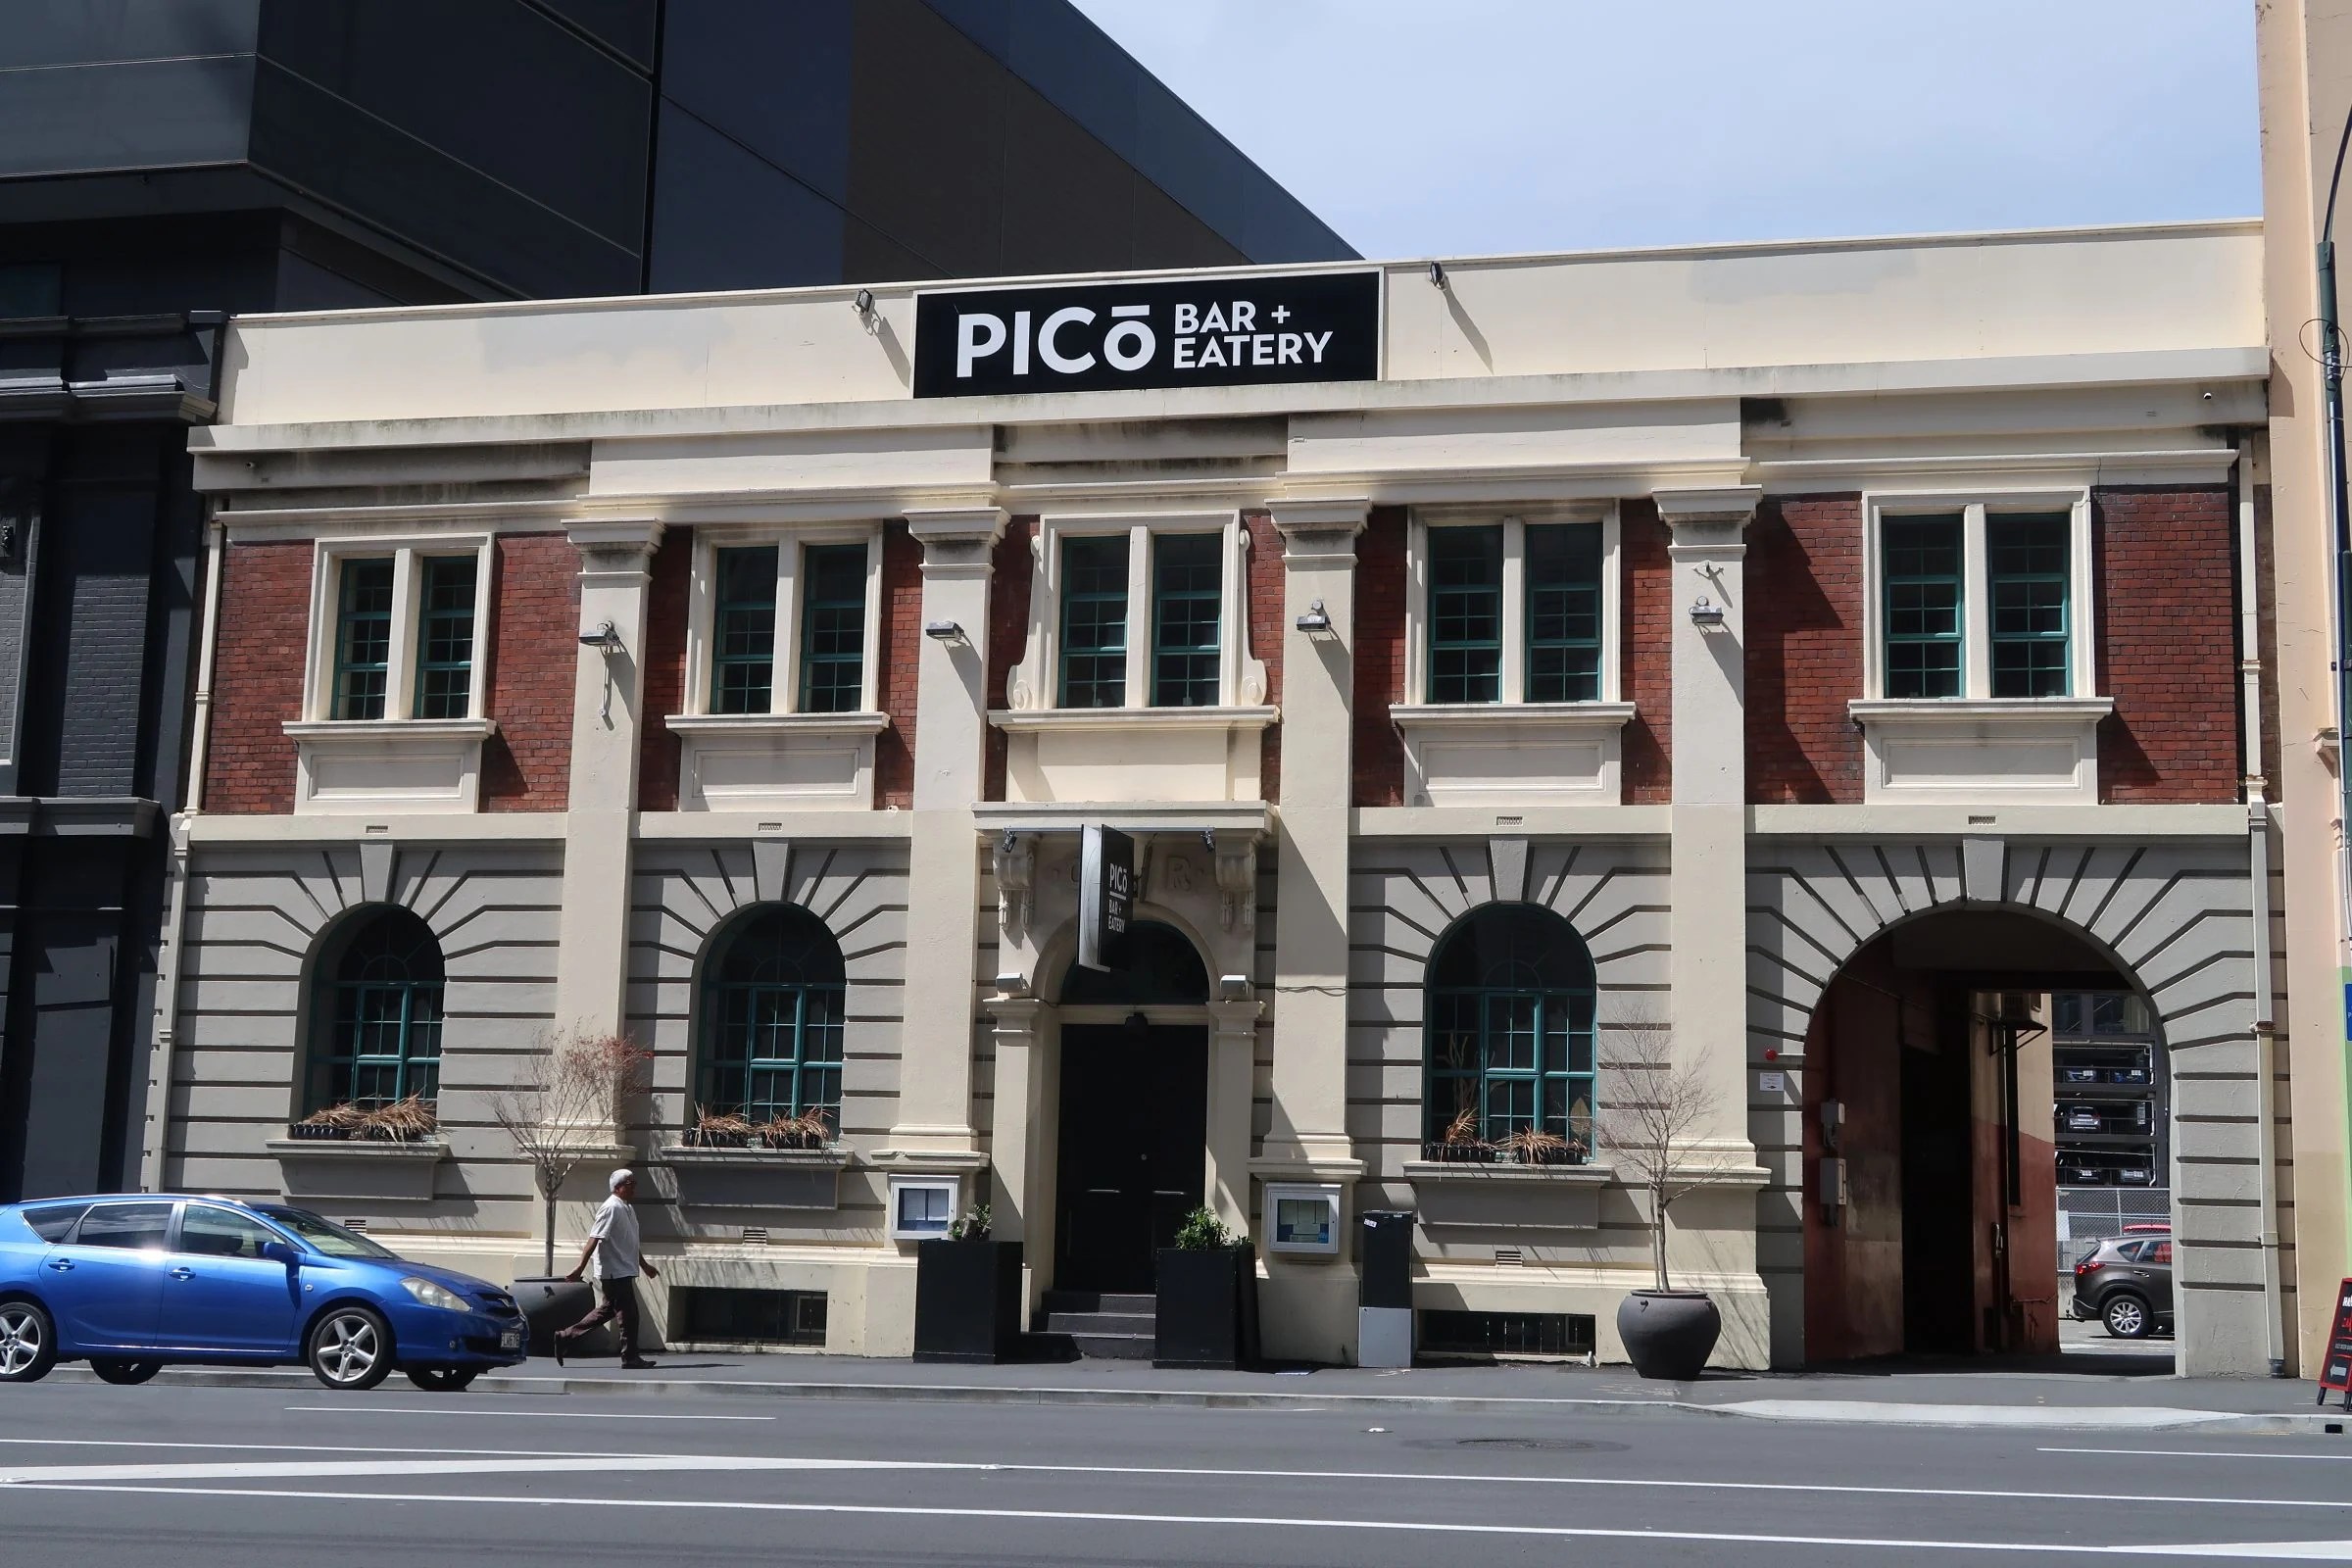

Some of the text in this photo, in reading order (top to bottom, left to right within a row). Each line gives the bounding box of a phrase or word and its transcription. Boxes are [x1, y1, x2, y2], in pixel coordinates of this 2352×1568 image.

[1174, 300, 1257, 335] BAR
[1173, 330, 1334, 369] EATERY
[1108, 899, 1118, 915] BAR
[1107, 915, 1125, 934] EATERY
